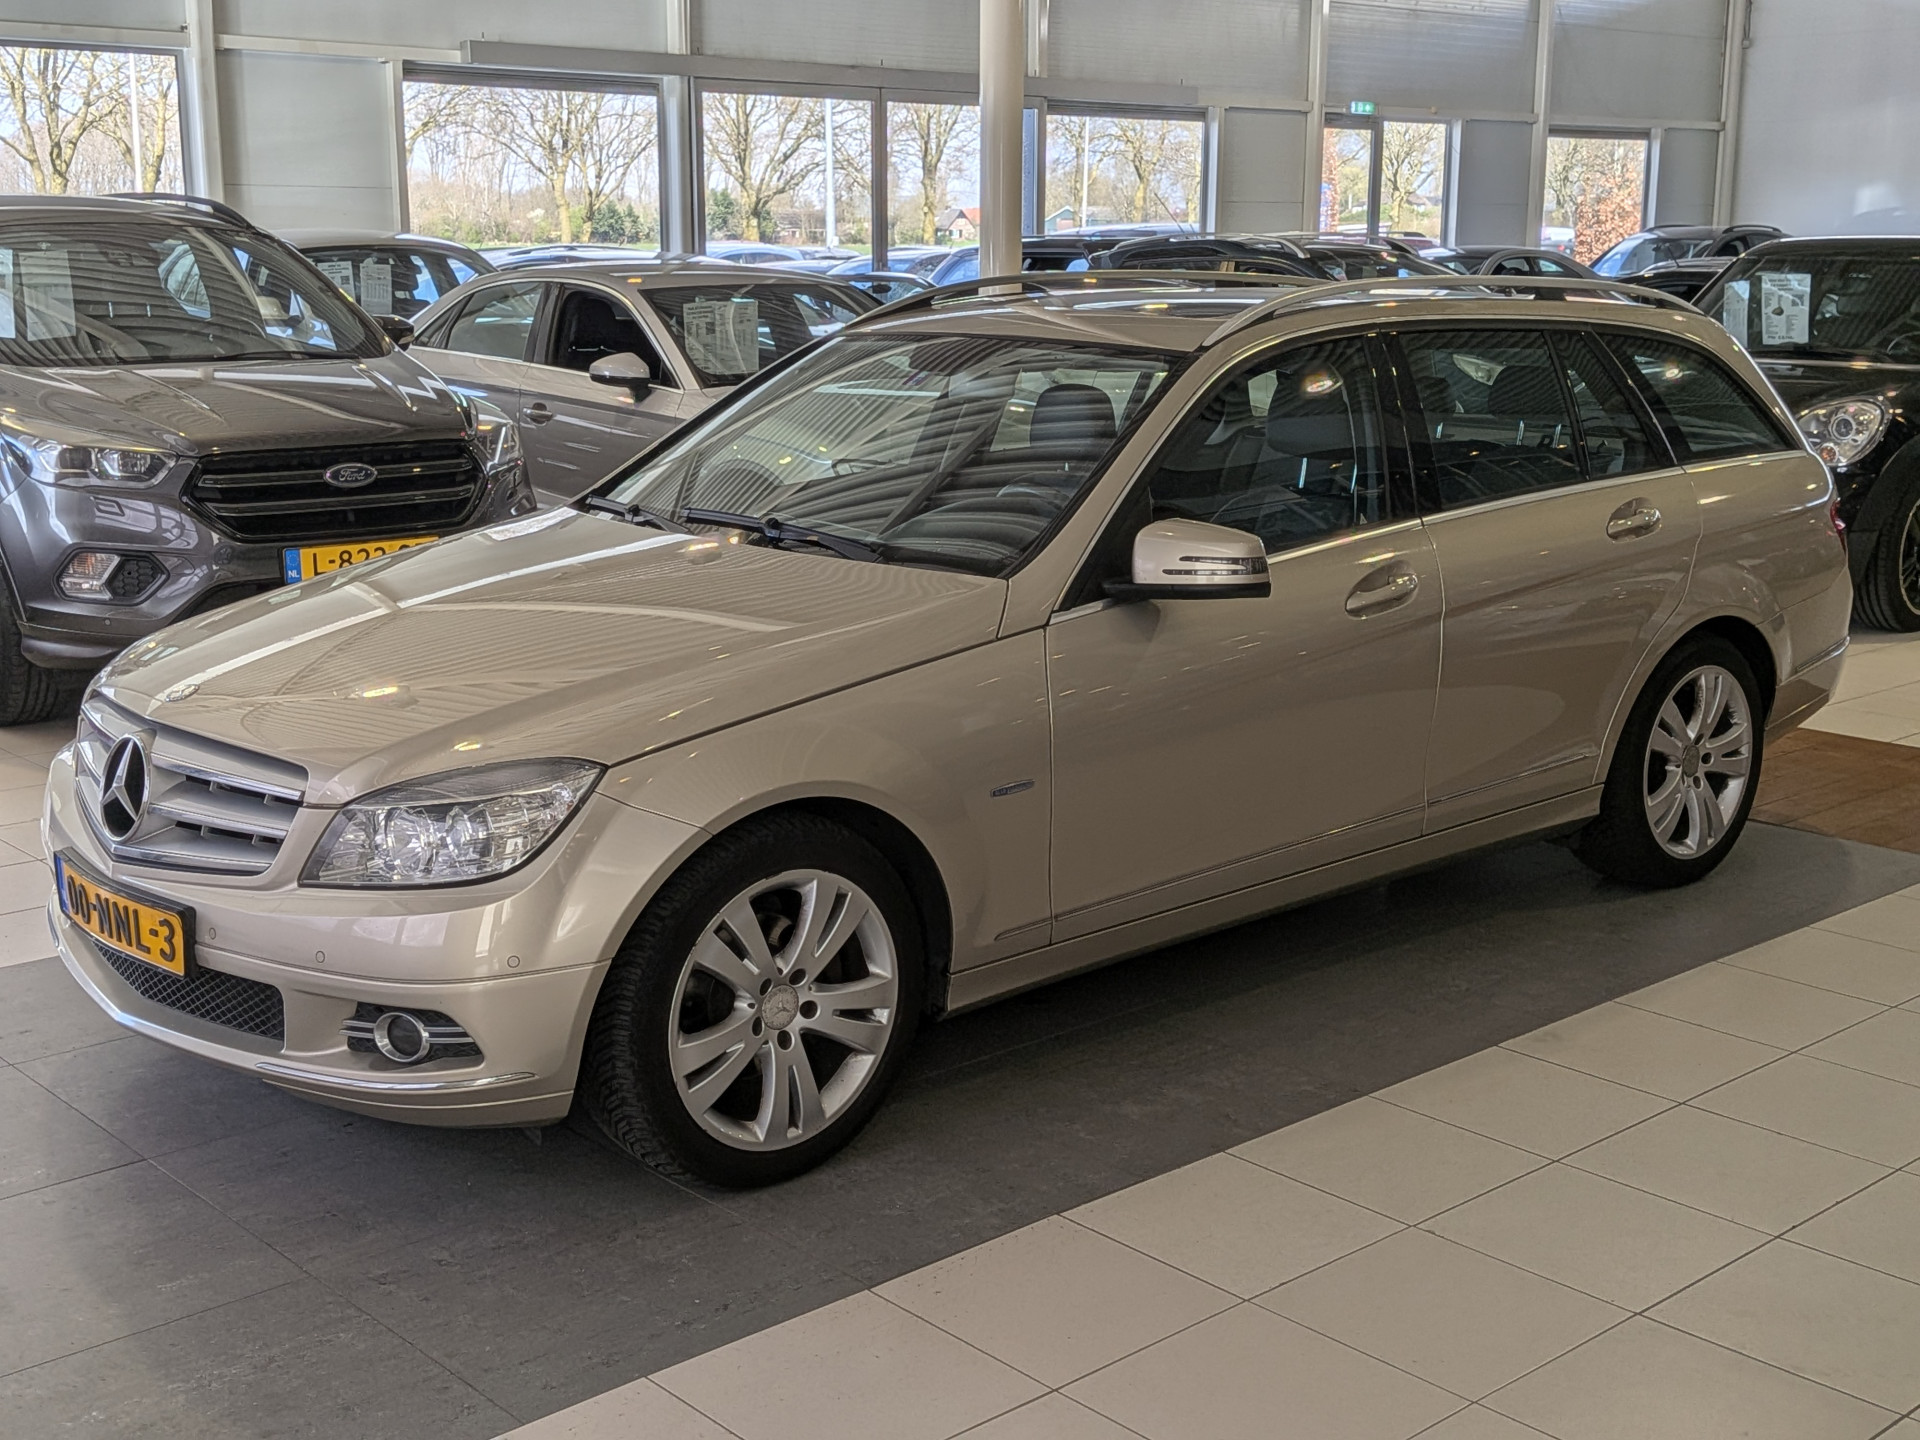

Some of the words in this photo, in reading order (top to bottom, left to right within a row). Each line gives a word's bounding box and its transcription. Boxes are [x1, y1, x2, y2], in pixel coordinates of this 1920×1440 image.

[339, 468, 366, 481] Ford
[288, 570, 300, 578] NL
[66, 874, 177, 963] 00-NNL-3
